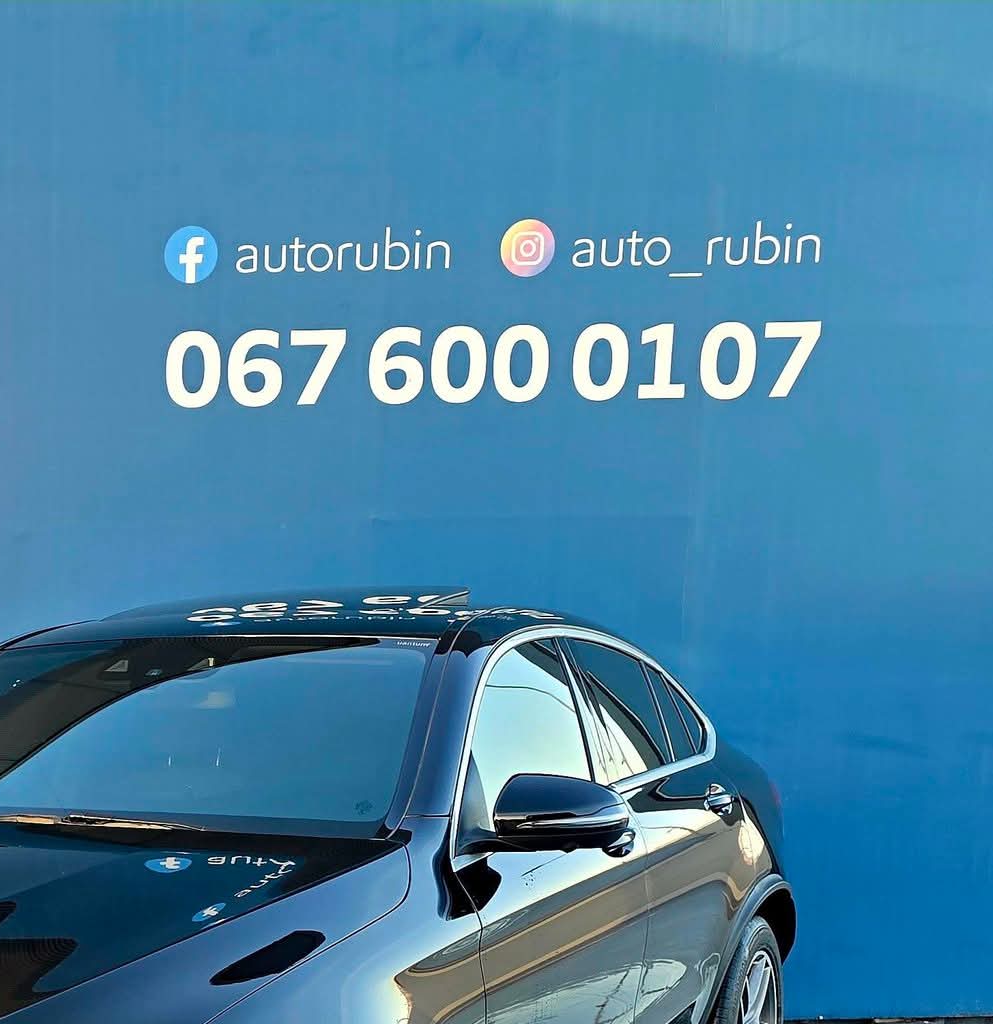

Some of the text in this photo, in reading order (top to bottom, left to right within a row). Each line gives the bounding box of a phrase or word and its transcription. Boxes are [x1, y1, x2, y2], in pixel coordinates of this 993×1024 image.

[235, 227, 451, 274] autorubin
[572, 221, 821, 277] auto_rubin
[165, 320, 822, 408] 067 600 0107
